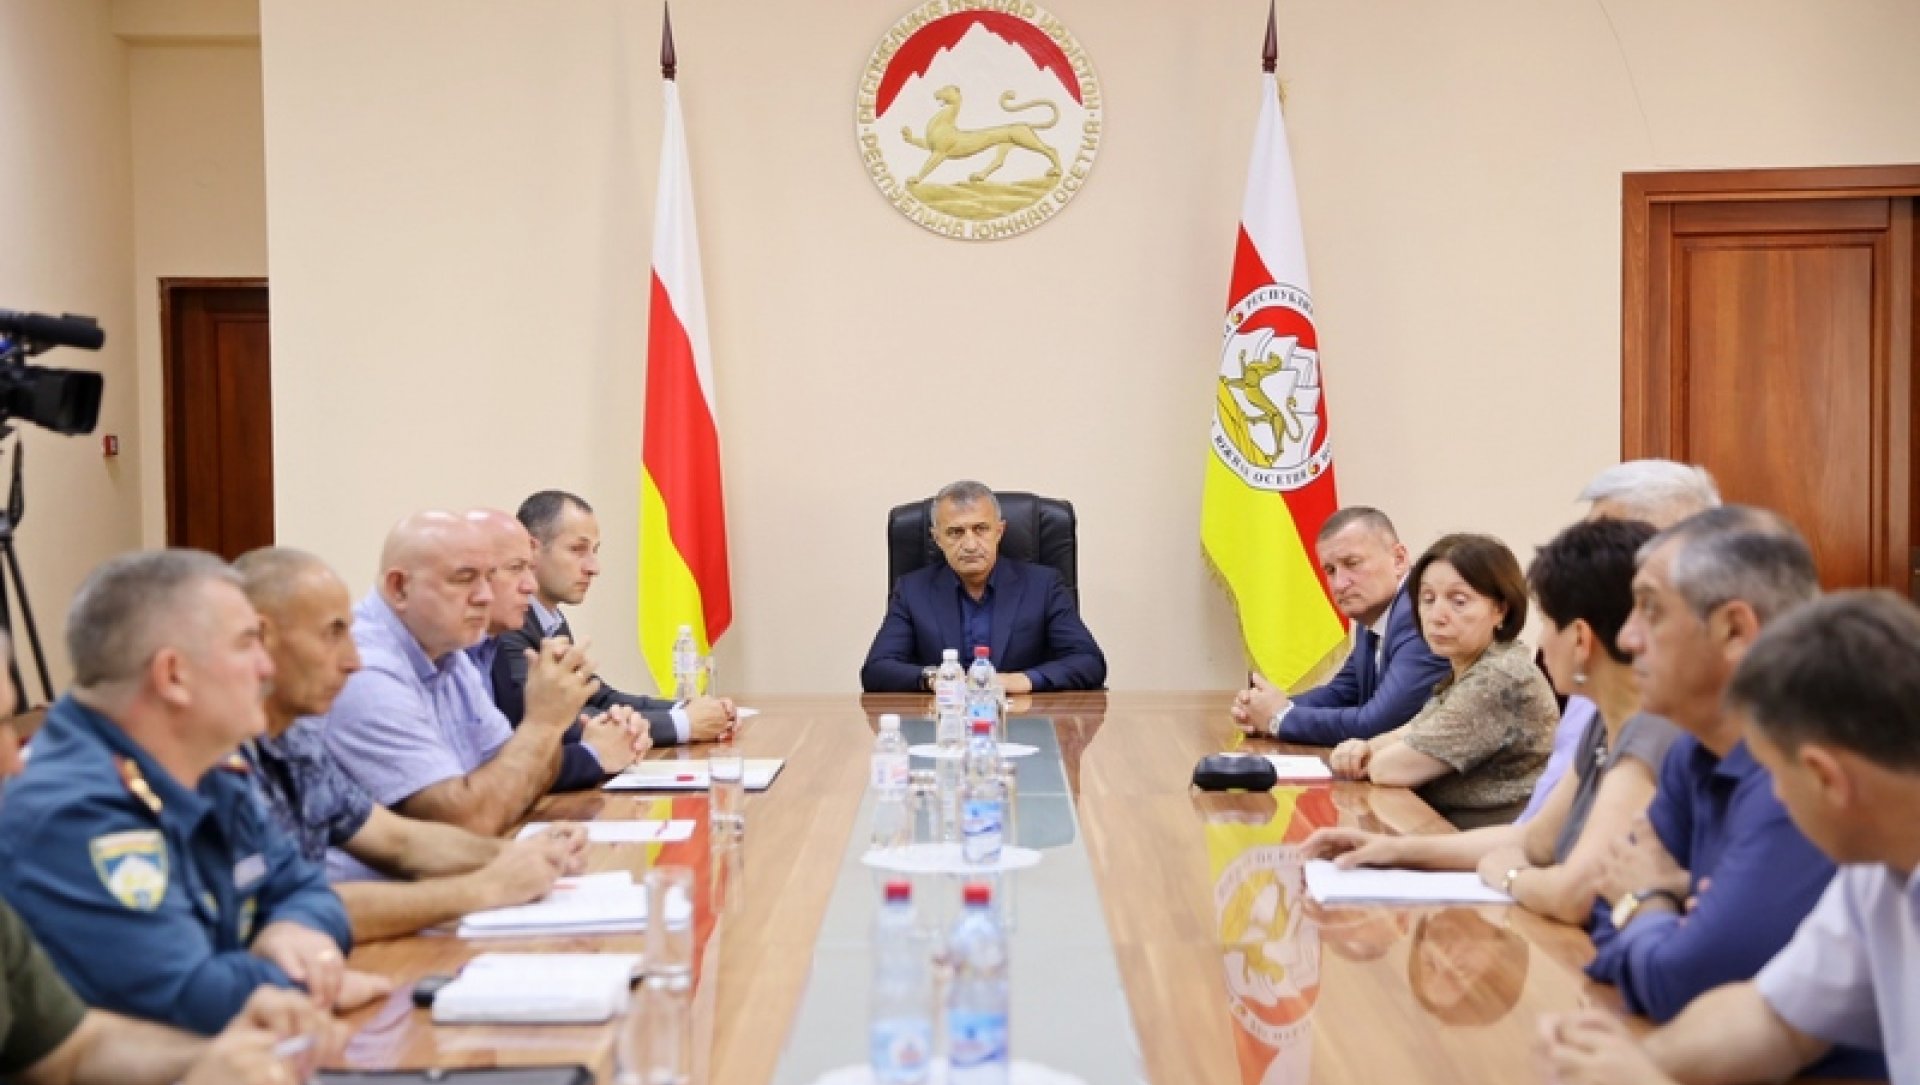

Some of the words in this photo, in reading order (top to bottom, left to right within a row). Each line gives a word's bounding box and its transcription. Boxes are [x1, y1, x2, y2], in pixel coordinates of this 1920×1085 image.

[861, 133, 964, 237] РЕСПУБЛИКА
[974, 203, 1052, 239] ЮЖНАЯ
[1055, 121, 1100, 204] ОСЕТИЯ
